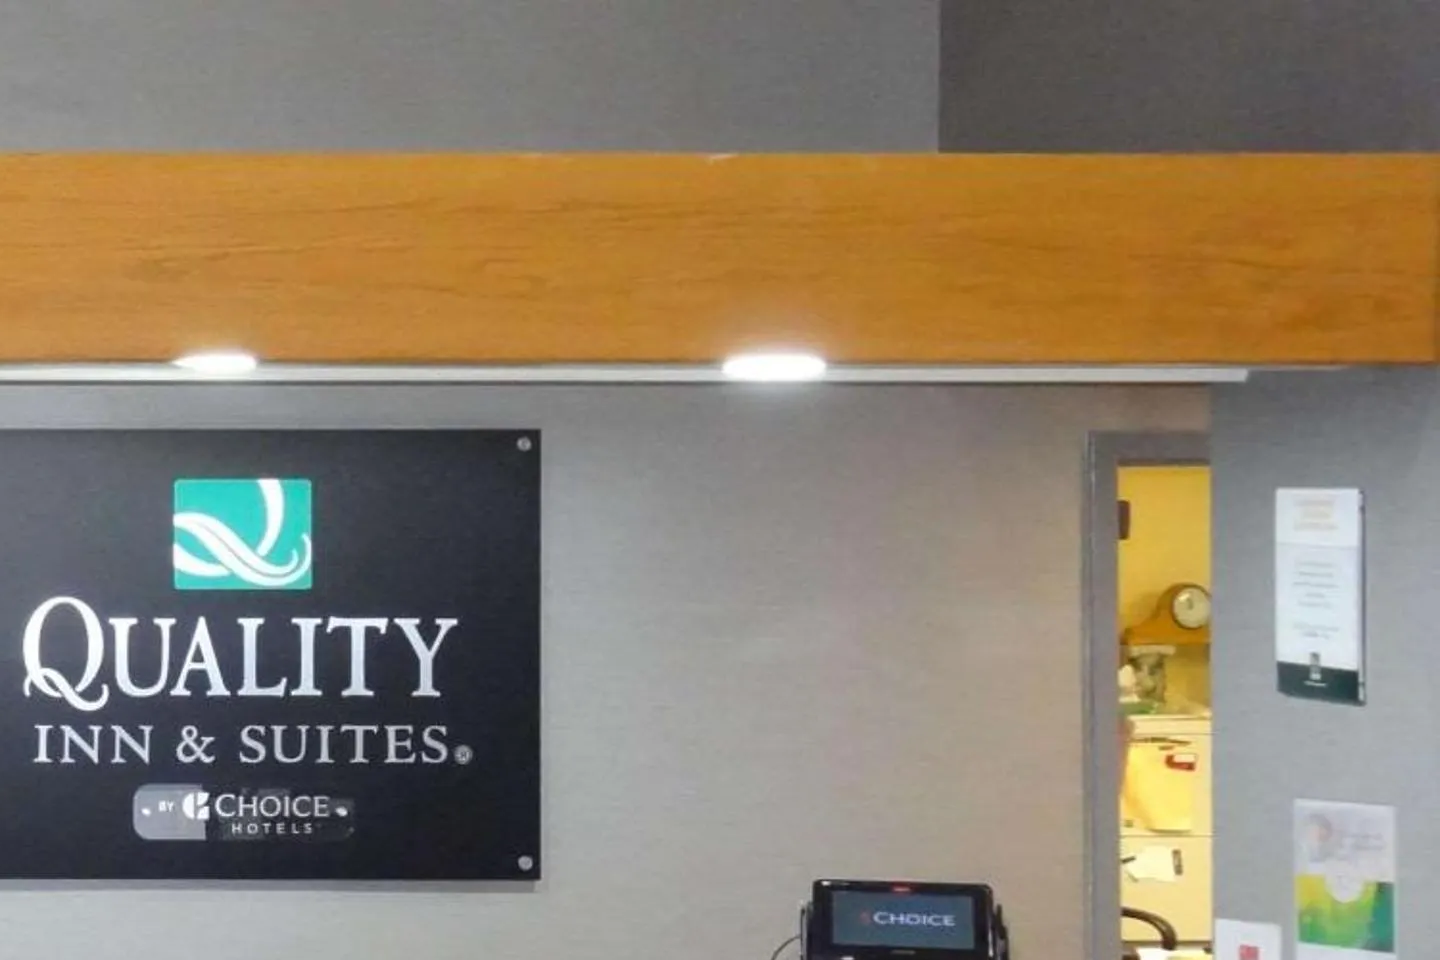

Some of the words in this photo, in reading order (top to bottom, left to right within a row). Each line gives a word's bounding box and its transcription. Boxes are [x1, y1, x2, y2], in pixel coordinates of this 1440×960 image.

[22, 595, 458, 712] QUALITY
[33, 724, 152, 764] INN
[175, 724, 215, 764] &
[158, 800, 174, 812] BY
[214, 793, 330, 818] CHOICE
[231, 822, 312, 835] HOTELS
[873, 911, 956, 927] CHOICE
